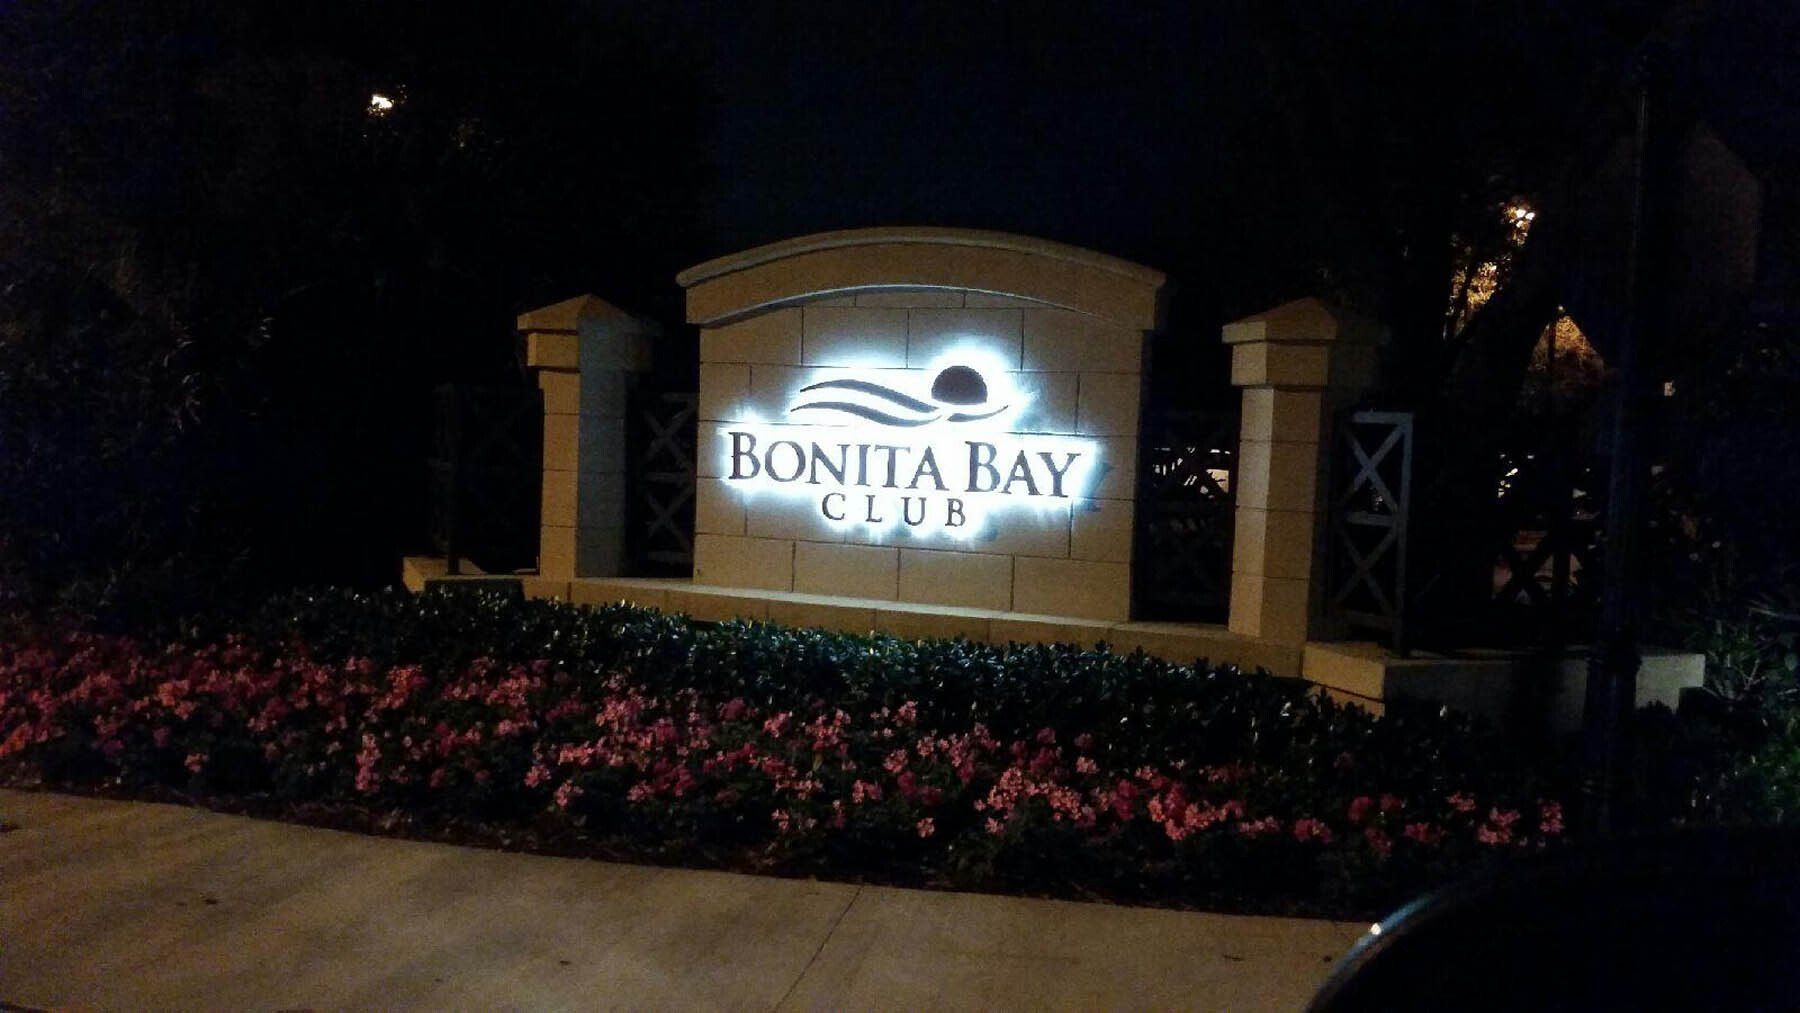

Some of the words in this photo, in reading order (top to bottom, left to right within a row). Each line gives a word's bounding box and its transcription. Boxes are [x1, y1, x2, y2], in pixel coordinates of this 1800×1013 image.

[728, 431, 950, 490] BONITA
[963, 440, 1082, 498] BAY
[821, 492, 967, 527] CLUB
